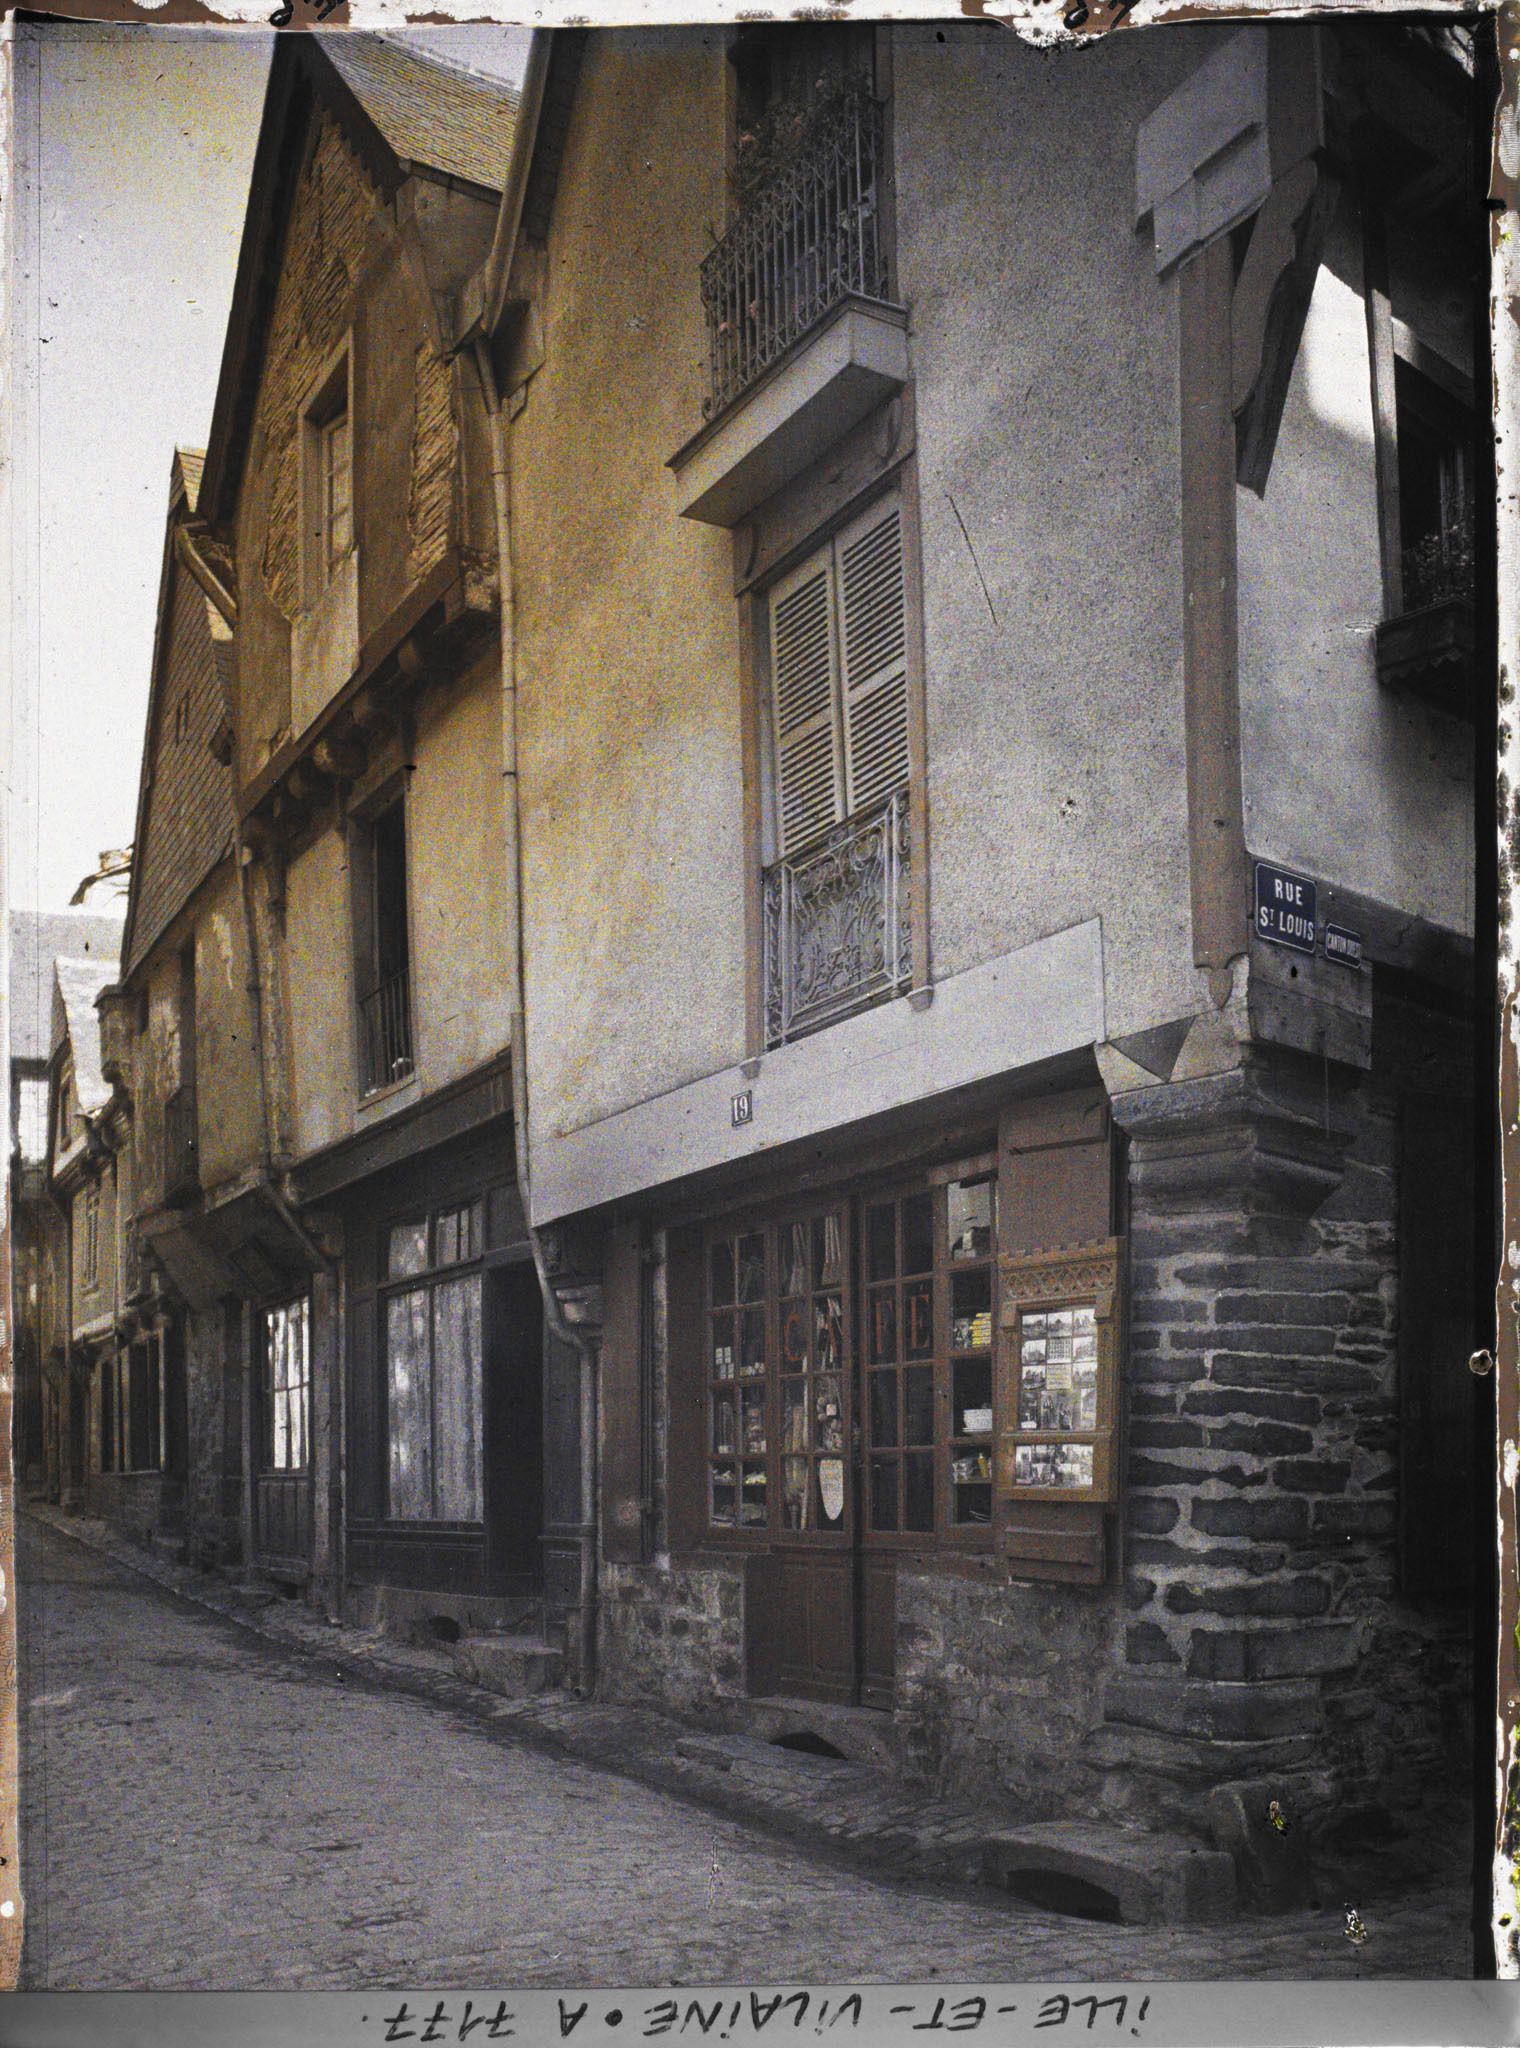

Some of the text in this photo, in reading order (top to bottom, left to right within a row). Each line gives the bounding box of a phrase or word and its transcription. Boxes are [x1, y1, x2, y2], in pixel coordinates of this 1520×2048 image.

[1274, 879, 1303, 906] RUE
[1280, 911, 1314, 941] LOUIS
[733, 1096, 748, 1121] 19
[557, 1998, 588, 2037] A
